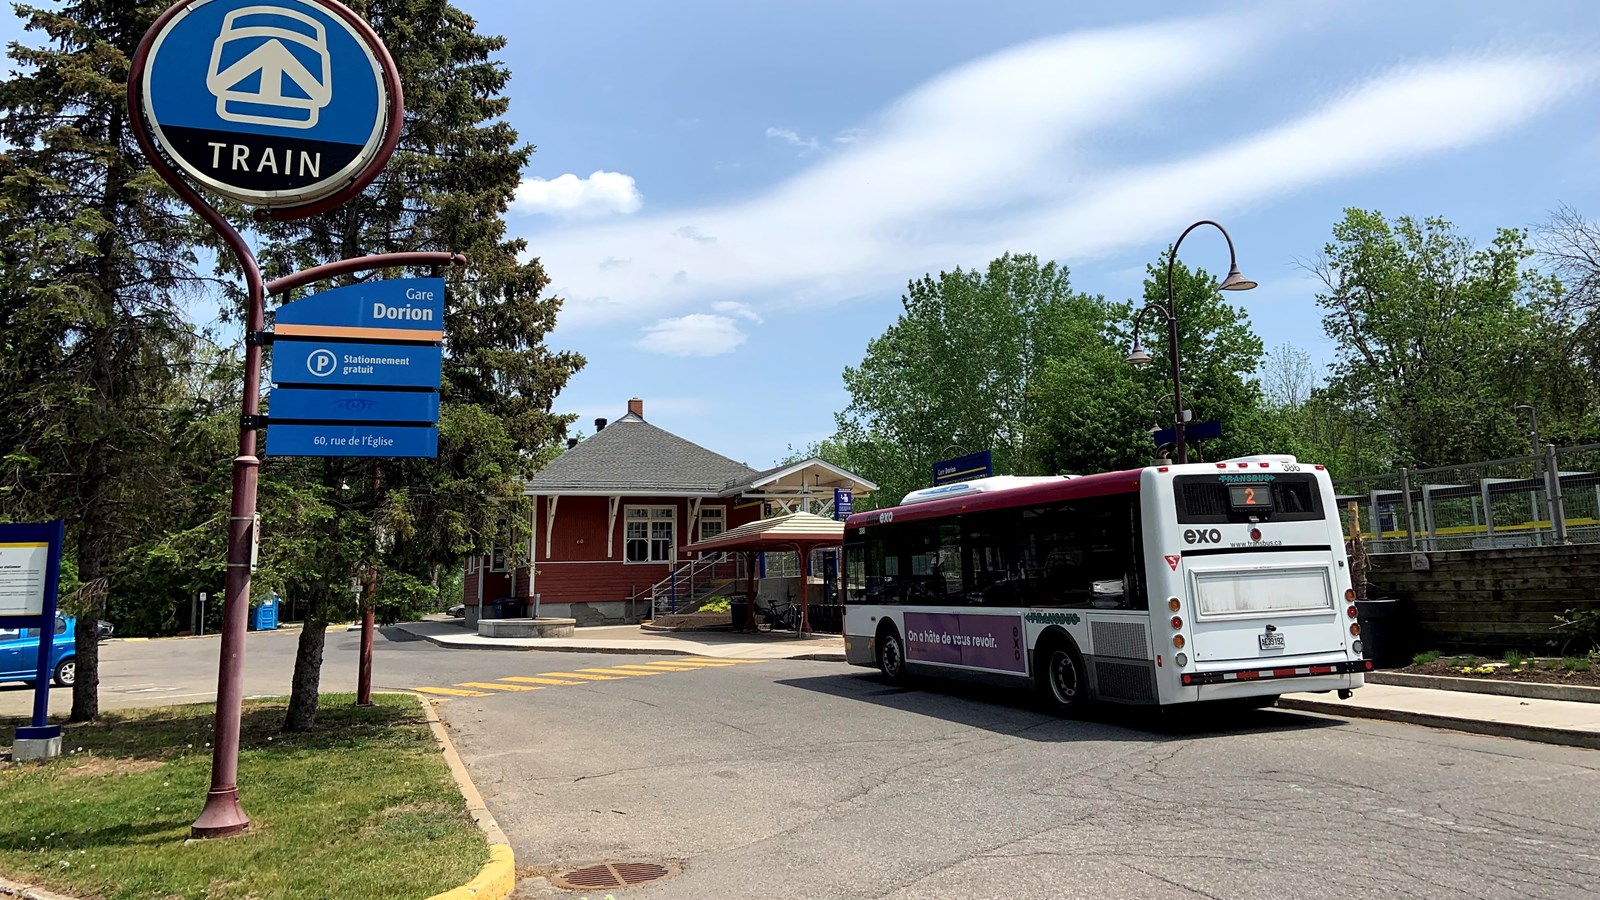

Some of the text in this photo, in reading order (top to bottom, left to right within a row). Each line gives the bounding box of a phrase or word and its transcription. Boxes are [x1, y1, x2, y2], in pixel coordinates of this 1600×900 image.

[207, 141, 322, 178] TRAIN
[406, 287, 434, 301] Gare
[373, 302, 433, 321] Dorion
[317, 355, 329, 372] P
[343, 354, 410, 366] Stationnement
[342, 365, 374, 375] gratuit
[313, 436, 328, 447] 60,
[330, 437, 346, 446] rue
[348, 436, 360, 446] de
[1282, 462, 1301, 473] 386
[1220, 473, 1270, 483] TRANSBUS
[1244, 486, 1256, 505] 2
[879, 511, 894, 524] exo
[1183, 528, 1222, 545] exo
[1229, 539, 1282, 548] www.transbus.ca
[1029, 612, 1079, 626] TRANSBUS
[908, 629, 998, 649] On a hâte de vous revoir.
[1012, 626, 1021, 661] exo
